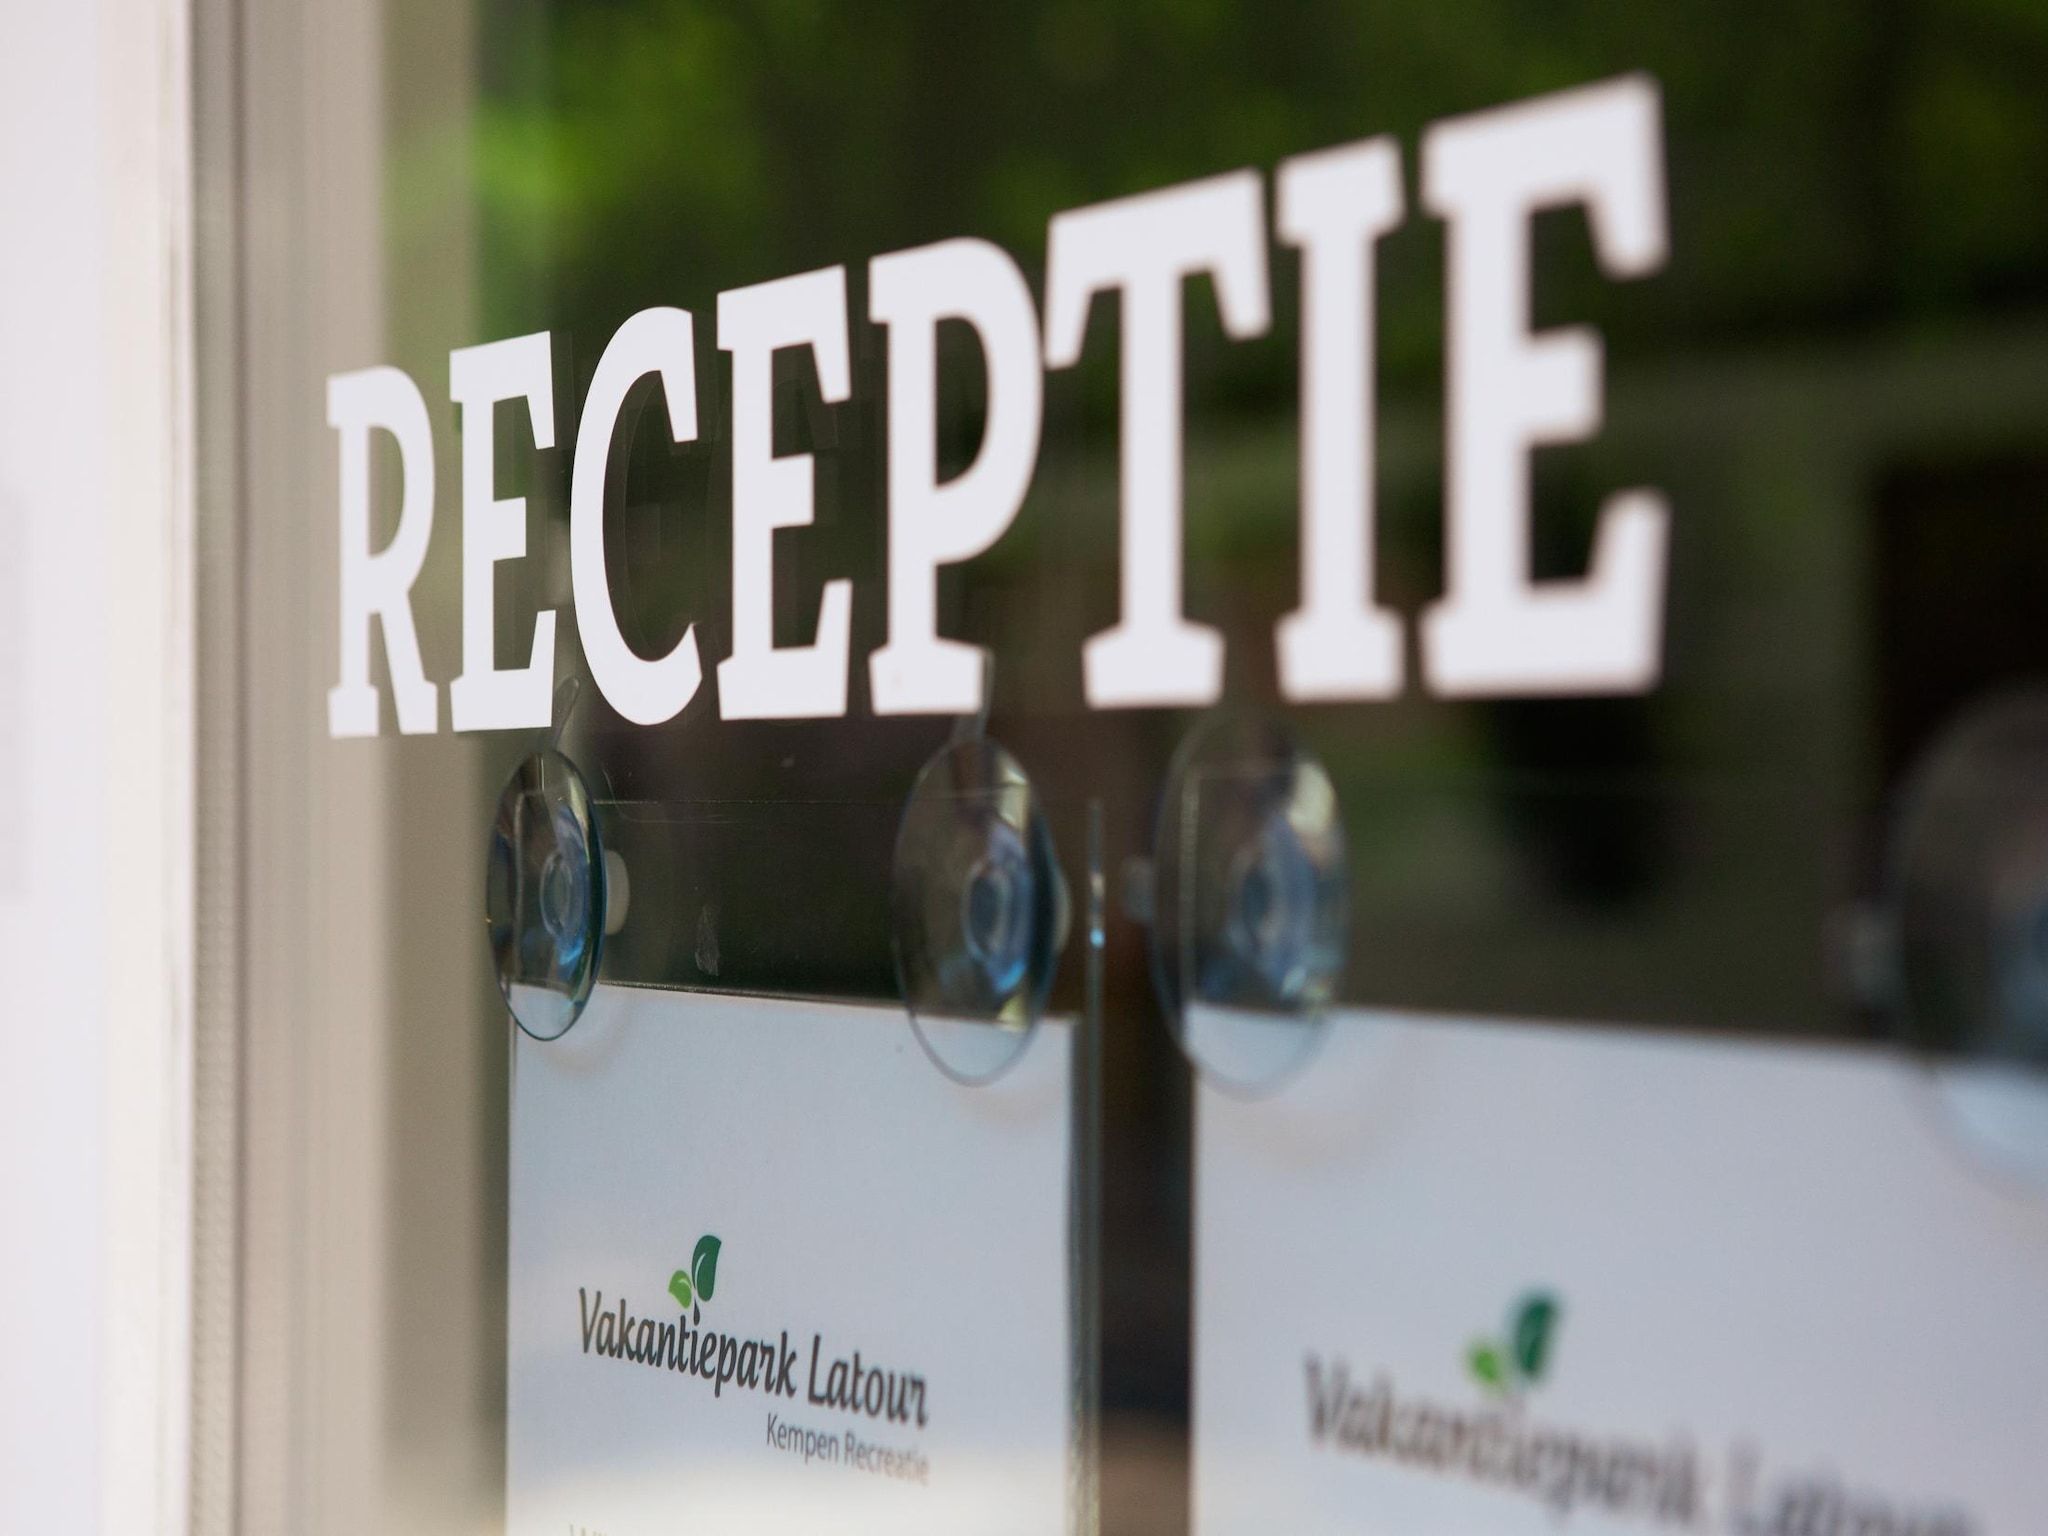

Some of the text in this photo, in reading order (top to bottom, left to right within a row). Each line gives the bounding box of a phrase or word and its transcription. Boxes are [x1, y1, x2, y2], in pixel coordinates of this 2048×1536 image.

[326, 73, 1670, 739] RECEPTIE
[578, 1287, 930, 1429] Vakantiepark Latour
[766, 1412, 929, 1487] Kempen Recreatie
